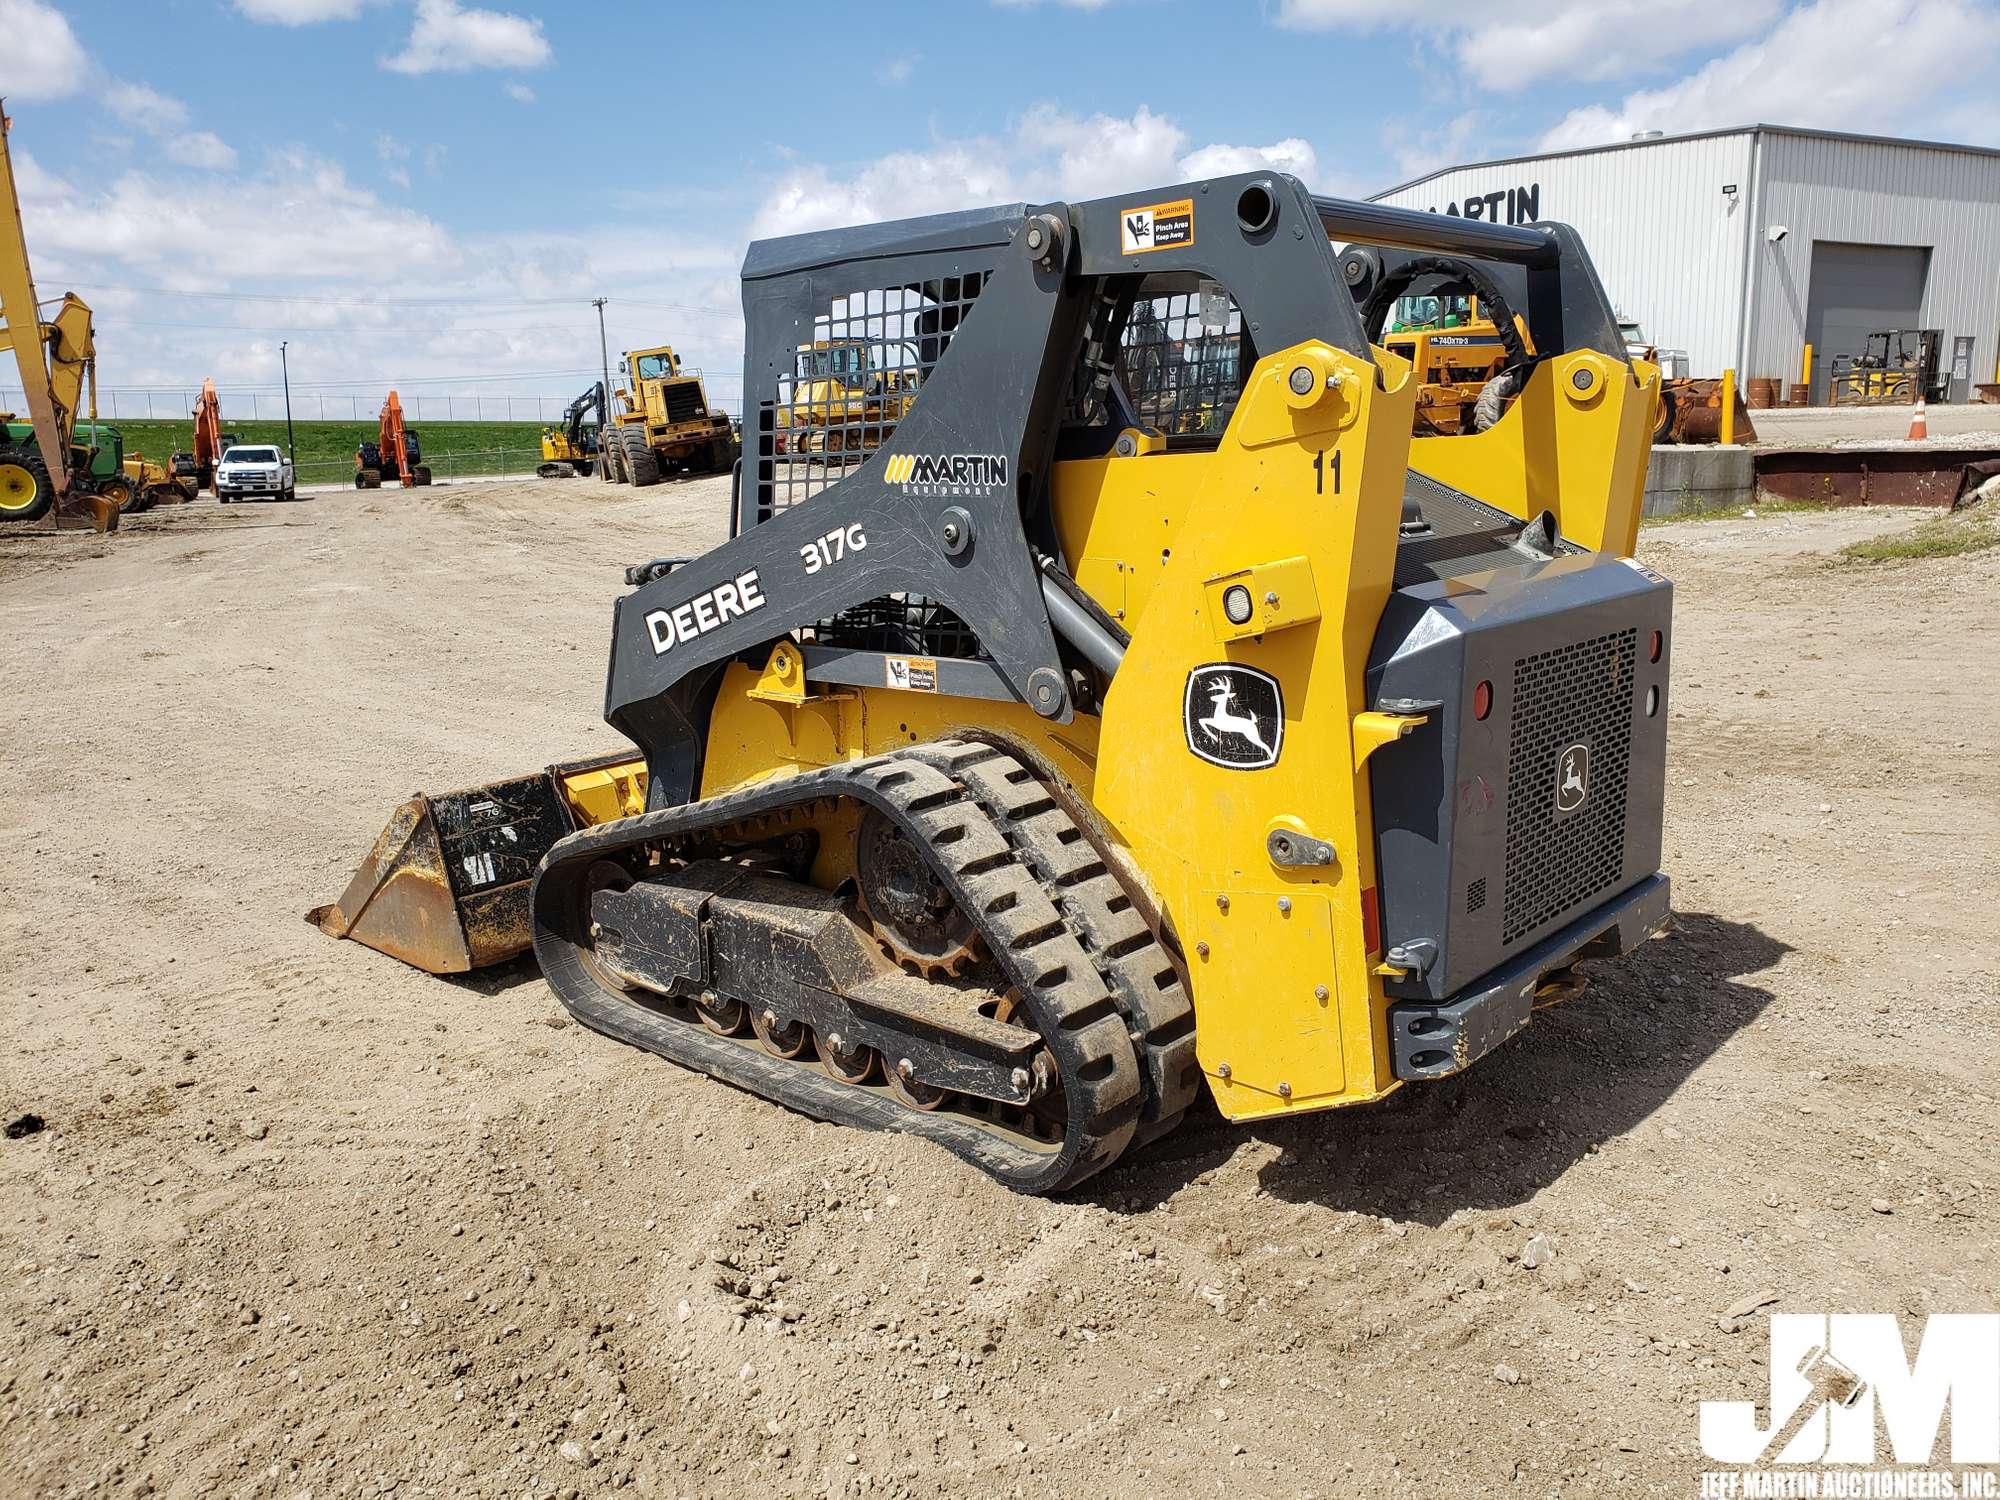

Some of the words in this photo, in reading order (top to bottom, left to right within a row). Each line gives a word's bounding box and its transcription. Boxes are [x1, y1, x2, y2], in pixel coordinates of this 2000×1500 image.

[1419, 183, 1540, 226] RTIN
[1155, 223, 1173, 232] Pinch
[1174, 221, 1189, 229] Area
[1156, 233, 1169, 241] Keep
[1170, 231, 1184, 239] Away
[910, 455, 1008, 486] MARTIN
[1313, 449, 1341, 495] 11
[800, 522, 868, 575] 317G
[645, 568, 767, 655] DEERE
